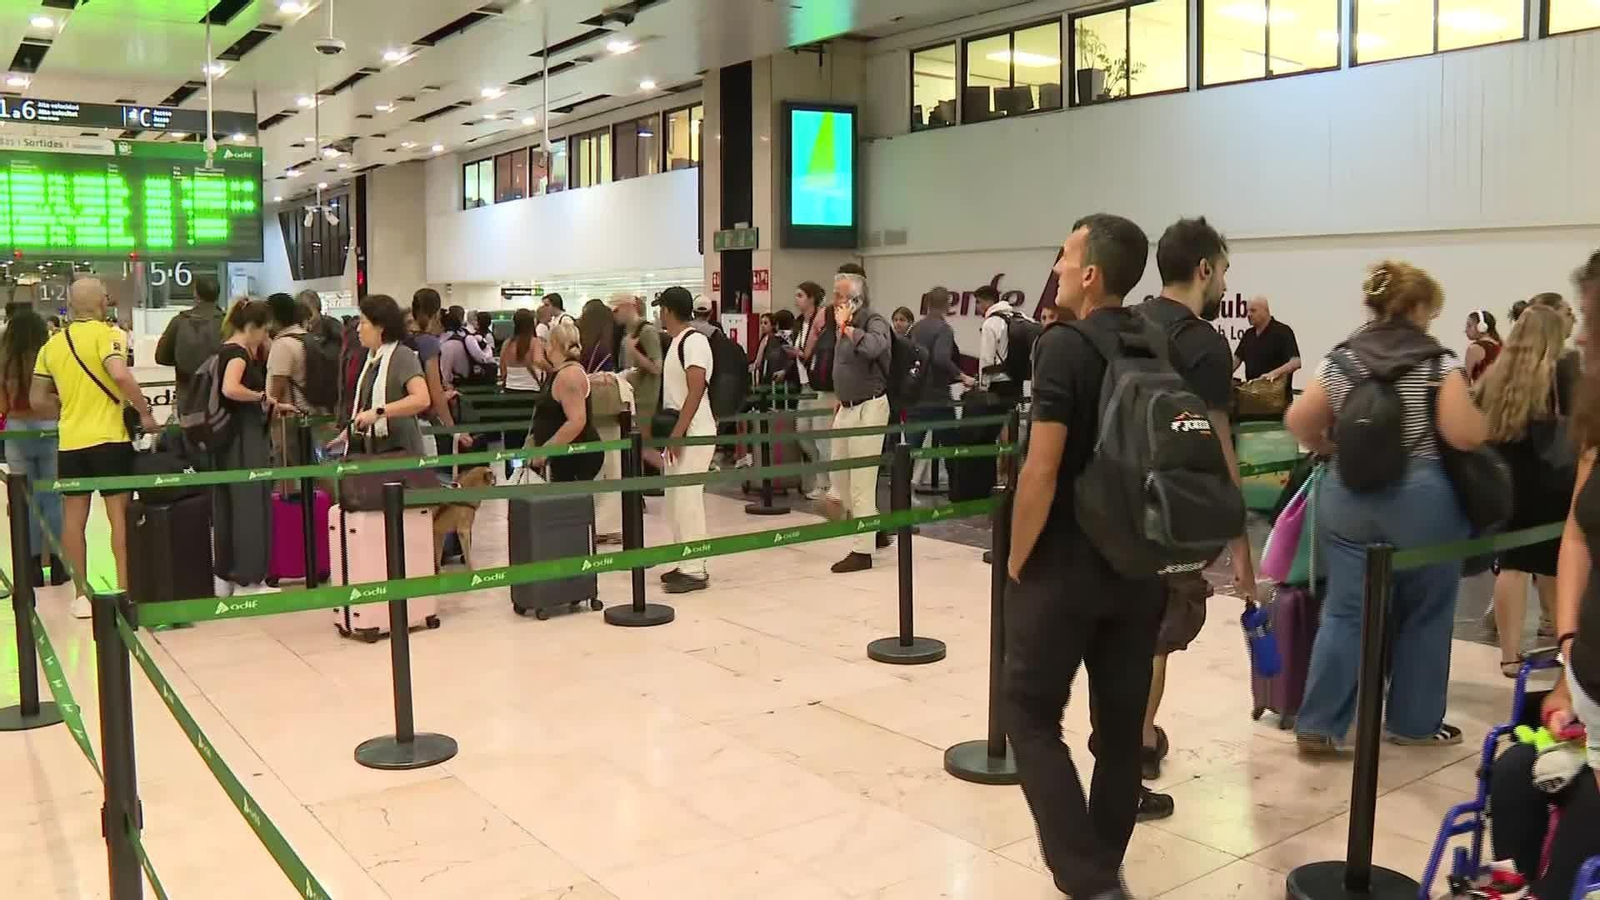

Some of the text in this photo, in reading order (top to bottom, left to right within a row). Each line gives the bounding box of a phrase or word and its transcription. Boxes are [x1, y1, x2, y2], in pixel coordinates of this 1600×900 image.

[140, 108, 151, 127] C
[23, 138, 63, 148] Sortides
[1220, 293, 1248, 319] ub
[1230, 325, 1245, 340] Lo
[592, 558, 613, 567] adif
[483, 572, 506, 583] adif
[362, 587, 387, 597] adif
[229, 600, 260, 611] adif
